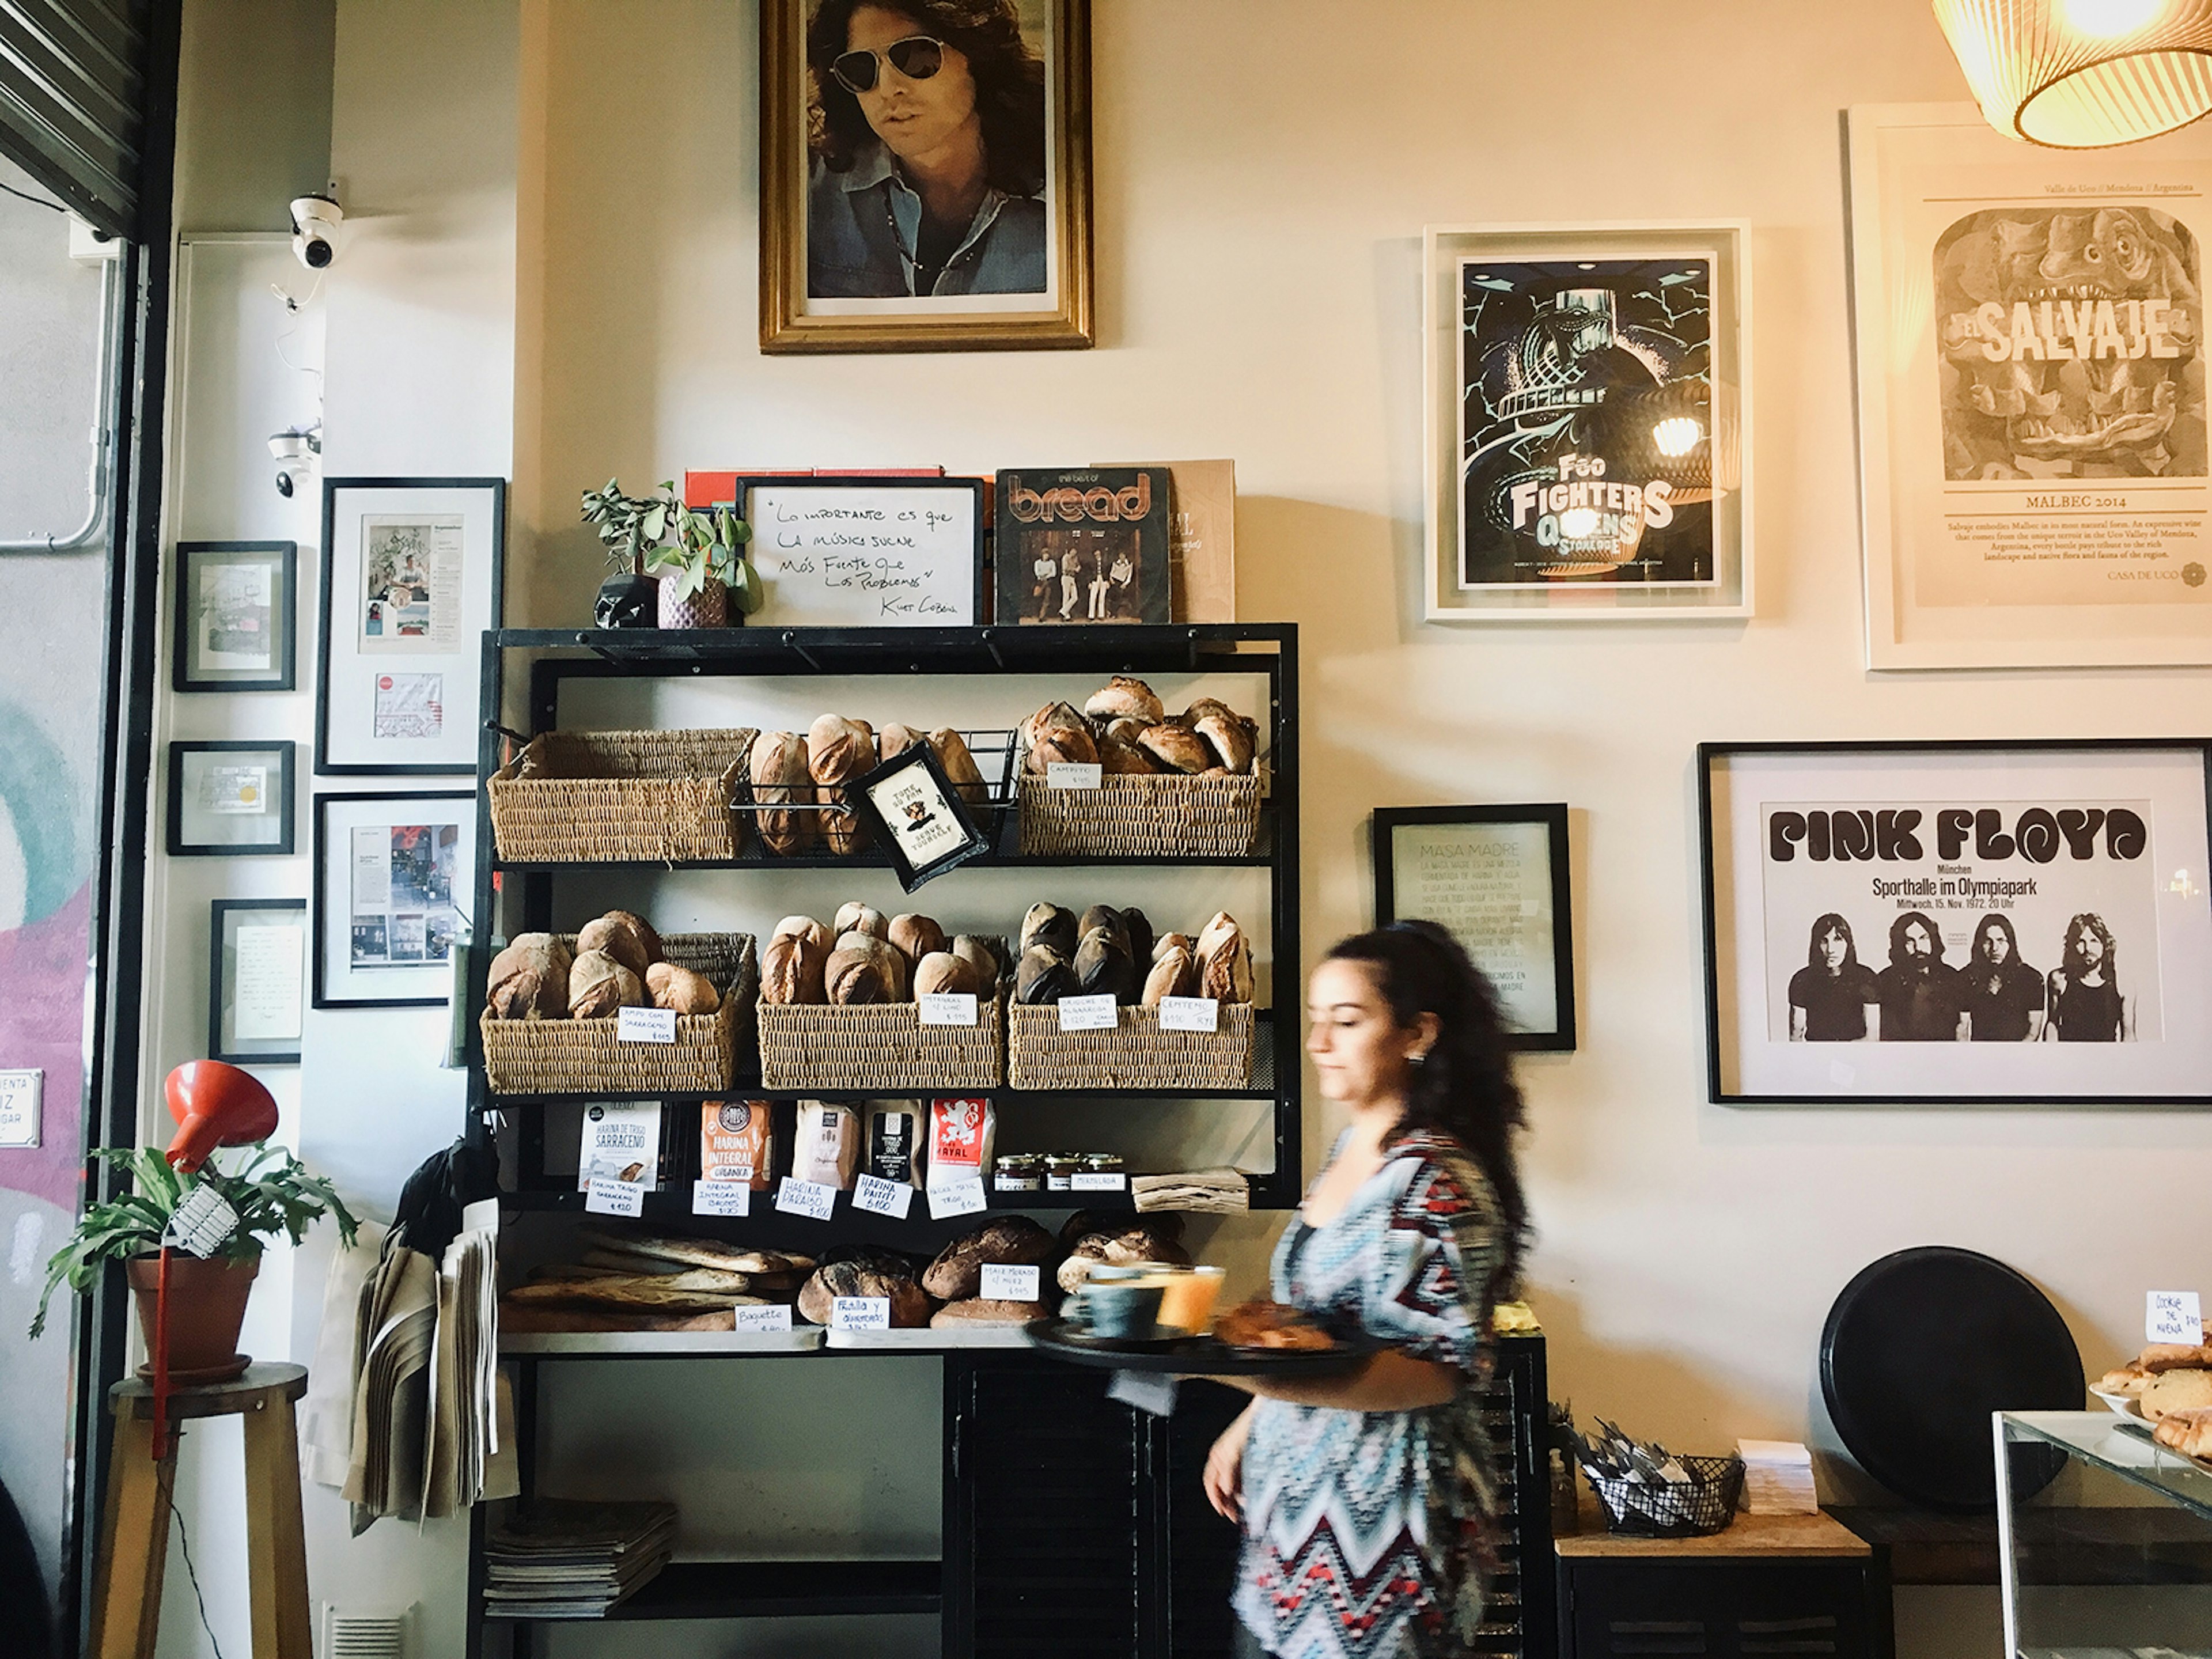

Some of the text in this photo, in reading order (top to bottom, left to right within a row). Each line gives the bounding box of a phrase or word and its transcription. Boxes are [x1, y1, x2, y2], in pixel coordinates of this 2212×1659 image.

[2044, 184, 2065, 193] Valle
[2067, 184, 2076, 192] de
[2106, 184, 2143, 192] Mendoza
[2153, 184, 2194, 193] Argentina
[1963, 321, 1980, 338] EL
[1976, 298, 2180, 362] SALVAJE
[1007, 472, 1152, 524] bread
[2026, 495, 2127, 508] MALBEC 2014
[1510, 480, 1673, 531] FIGHTERS
[1948, 522, 1973, 532] Salvaje
[1975, 522, 2009, 530] embodies
[2145, 521, 2182, 529] expressive
[2031, 533, 2055, 541] unique
[2125, 530, 2148, 539] Valley
[2150, 529, 2158, 537] of
[2160, 530, 2198, 538] Mendoza,
[1991, 543, 2031, 552] Argentina,
[2078, 543, 2094, 551] pays
[1984, 552, 2020, 563] landscape
[2023, 552, 2036, 560] and
[2097, 551, 2118, 559] fauna
[2120, 550, 2128, 558] of
[2129, 550, 2141, 558] the
[2143, 551, 2169, 560] region.
[2108, 570, 2179, 579] CASA DE UCO
[1770, 810, 1923, 862] PINK
[1937, 807, 2147, 864] FLOYD
[1421, 842, 1520, 858] MASA MADRE
[1937, 865, 1972, 874] München
[1873, 878, 2037, 898] Sporthalle im Olympiapark
[1936, 899, 1946, 908] 15.
[1948, 899, 1964, 908] Nov.
[1988, 898, 1999, 908] 20
[2001, 898, 2015, 908] Uhr
[1197, 1016, 1214, 1026] RYE
[0, 1079, 27, 1090] ENTA
[596, 1124, 619, 1134] HARINA
[621, 1124, 628, 1134] DE
[596, 1134, 645, 1148] SARRACENO
[714, 1136, 749, 1150] HARINA
[709, 1151, 752, 1165] INTEGRAL
[861, 1177, 896, 1192] HARINA
[2156, 1295, 2183, 1311] Cookie
[739, 1309, 782, 1324] Baguette
